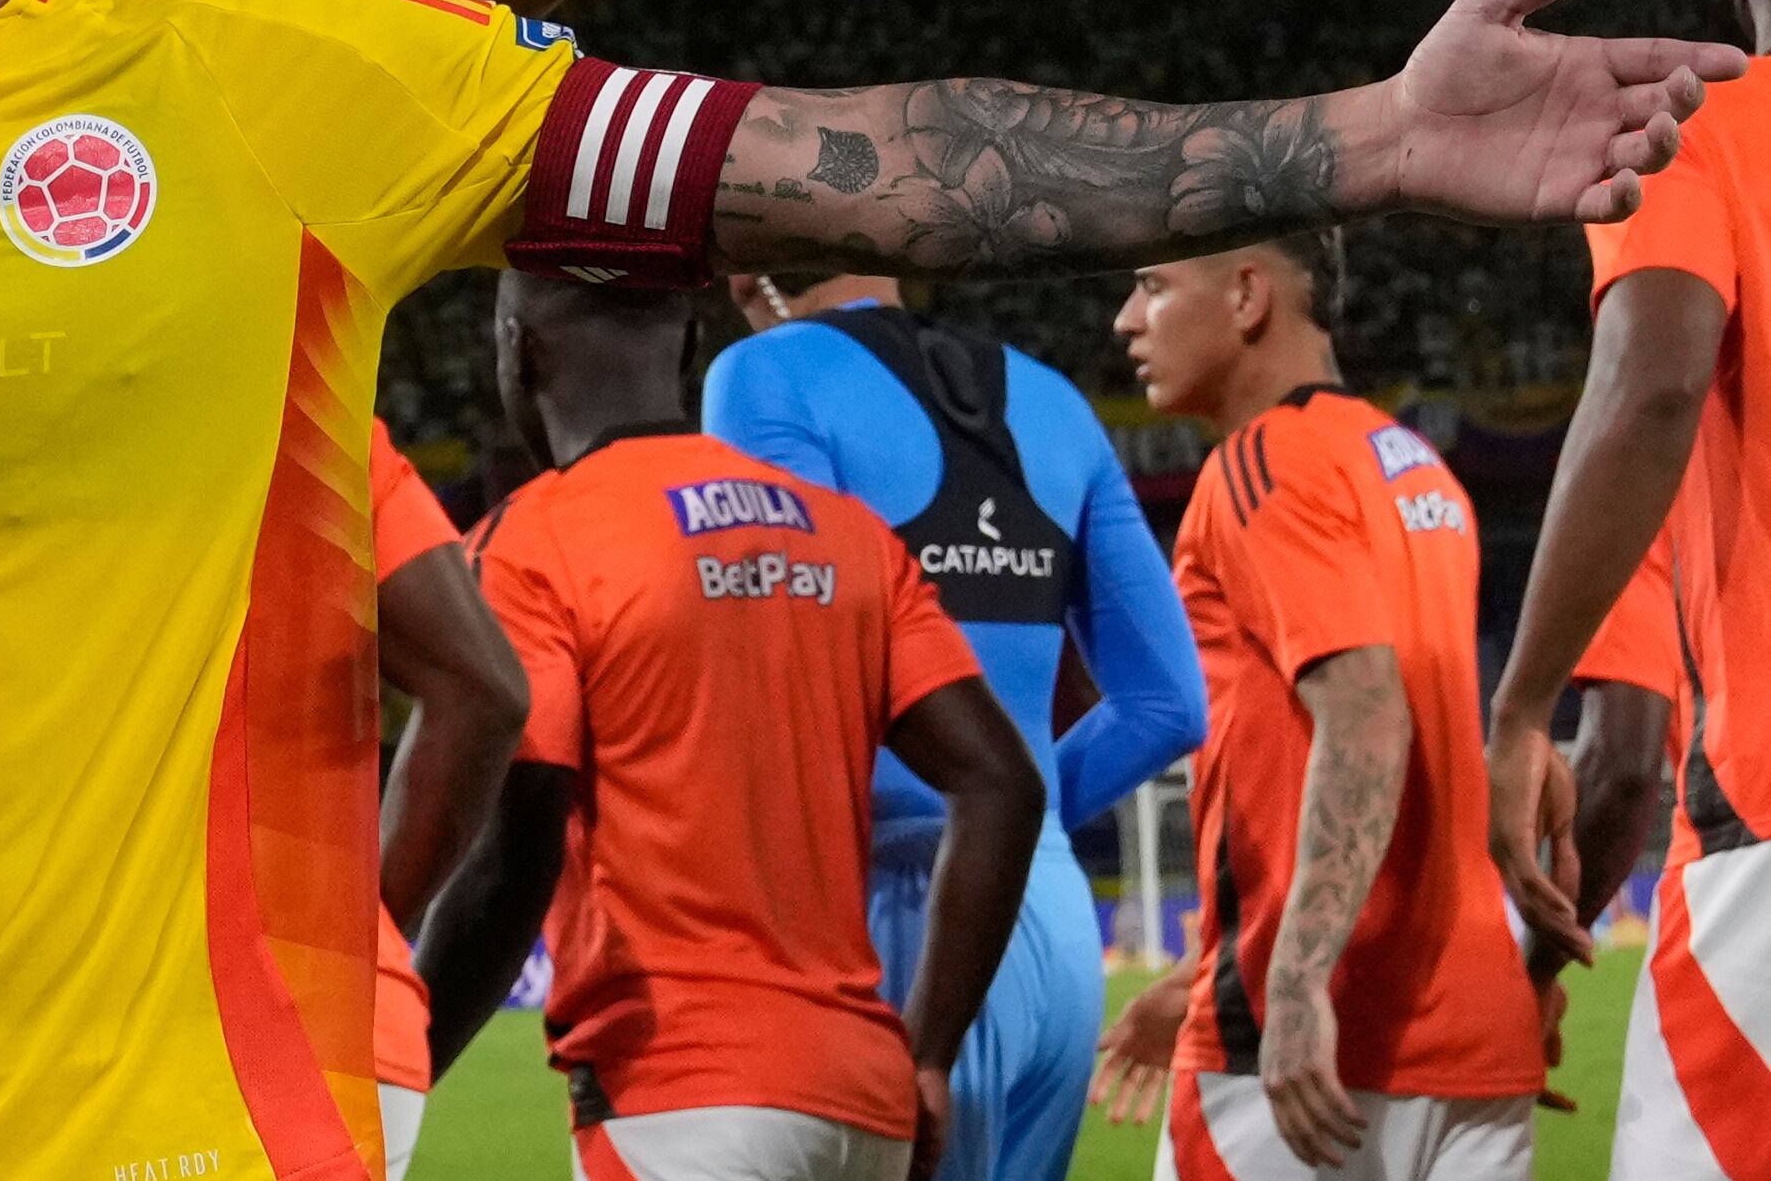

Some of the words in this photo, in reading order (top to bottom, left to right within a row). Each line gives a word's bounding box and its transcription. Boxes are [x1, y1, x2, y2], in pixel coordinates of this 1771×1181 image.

[35, 120, 109, 141] COLOMBIANA
[110, 130, 126, 144] DE
[919, 543, 1056, 578] CATAPULT
[697, 551, 835, 606] BetPay
